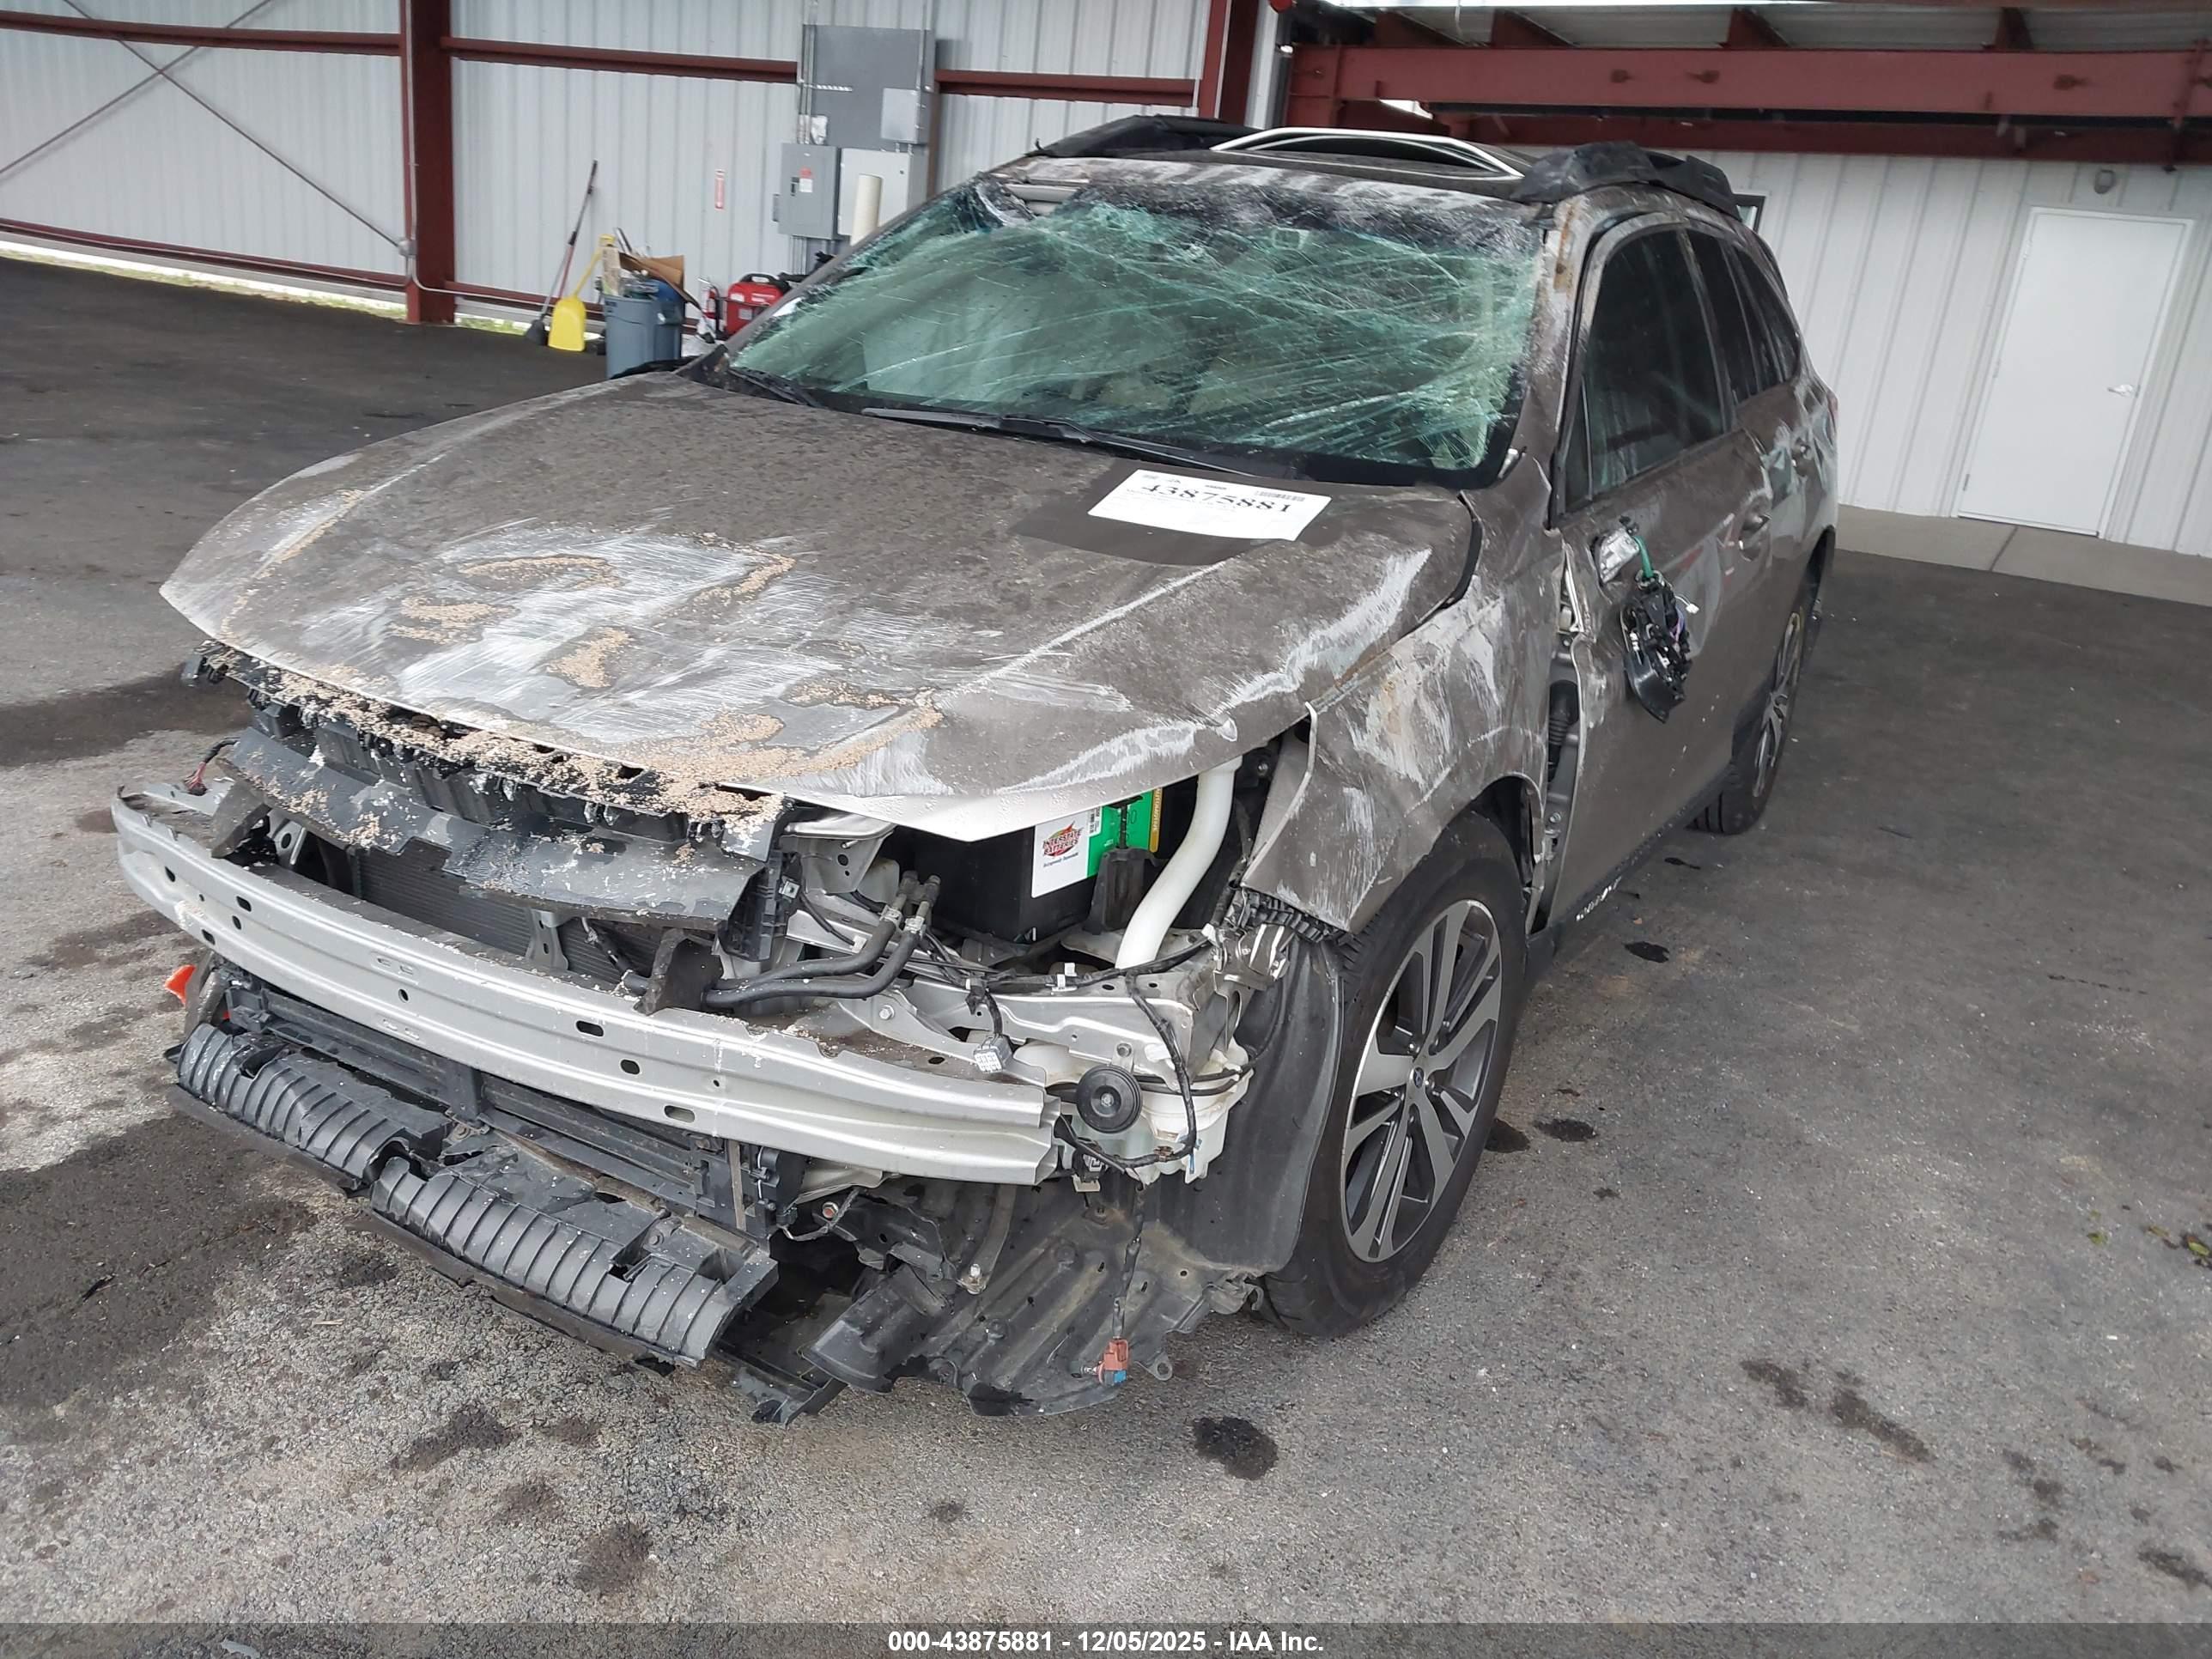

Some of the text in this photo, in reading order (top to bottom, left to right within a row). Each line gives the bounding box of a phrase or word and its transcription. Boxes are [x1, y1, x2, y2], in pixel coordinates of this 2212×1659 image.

[1142, 483, 1291, 513] 43875881
[1042, 828, 1083, 848] INTERSTATE
[1043, 839, 1079, 855] BATTERIES
